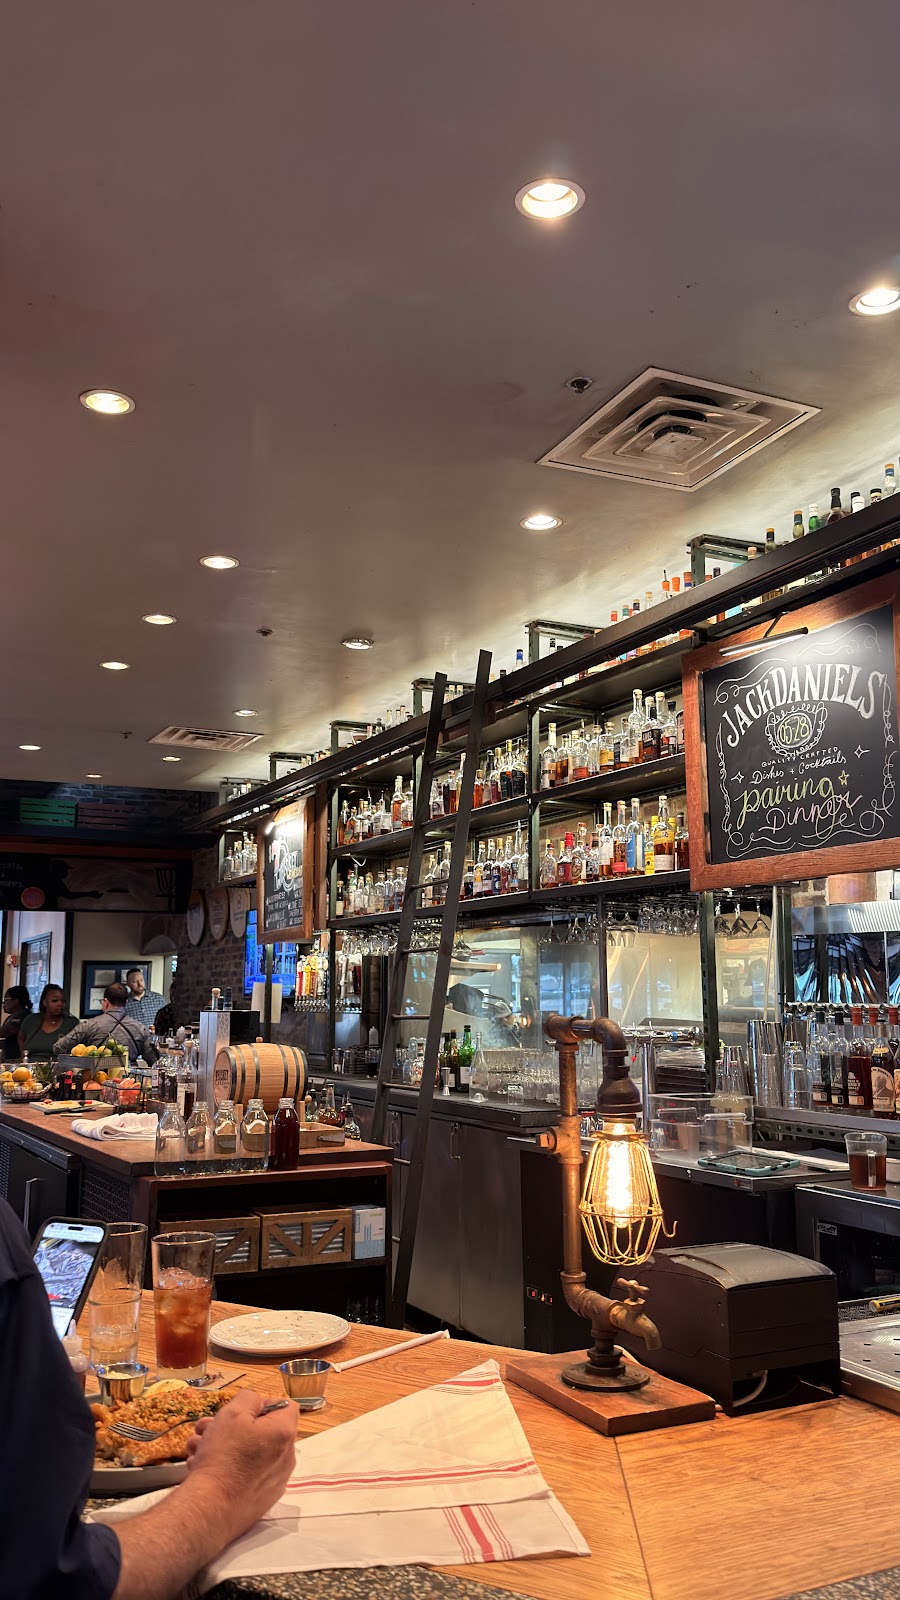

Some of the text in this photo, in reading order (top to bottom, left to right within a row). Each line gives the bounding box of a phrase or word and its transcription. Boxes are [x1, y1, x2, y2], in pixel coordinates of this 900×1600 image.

[750, 766, 784, 785] Dishes
[798, 750, 847, 775] Cocktails
[761, 746, 839, 768] QUALITY CRAFTED
[758, 790, 863, 834] Dinner
